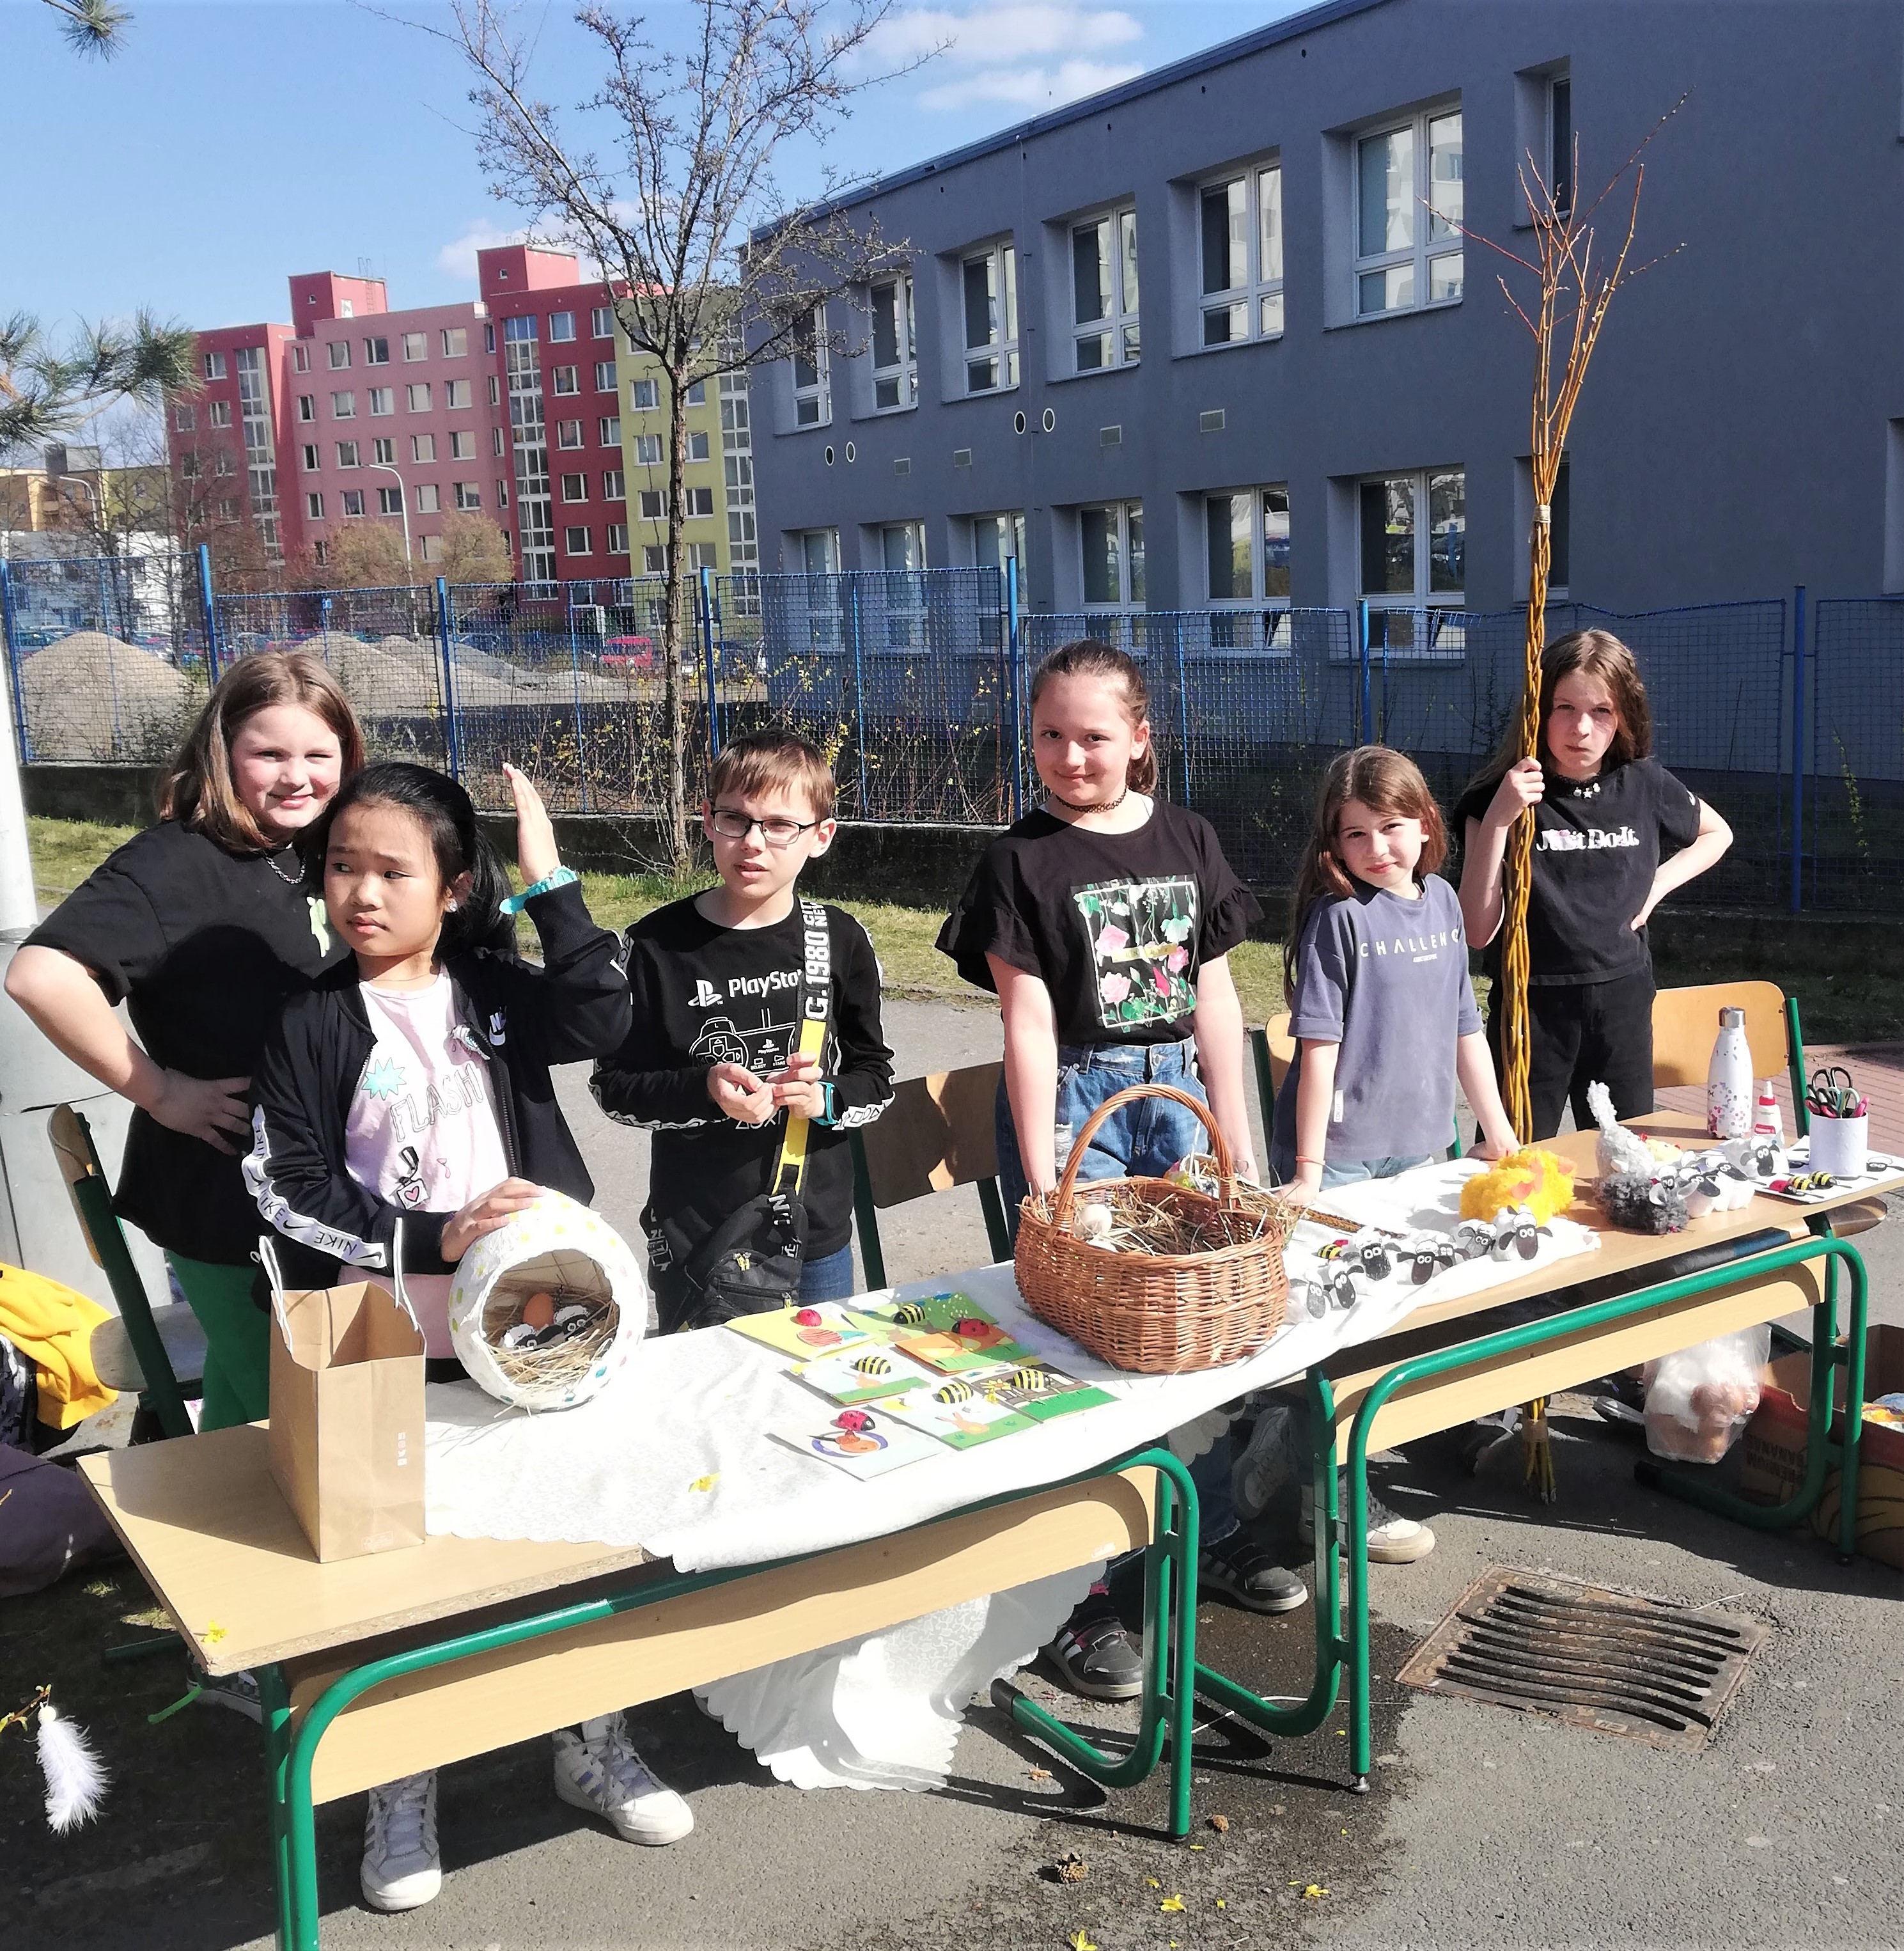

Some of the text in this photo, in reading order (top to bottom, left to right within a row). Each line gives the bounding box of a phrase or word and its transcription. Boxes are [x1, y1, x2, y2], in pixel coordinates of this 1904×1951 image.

[804, 930, 830, 1019] G. 1980
[389, 1063, 484, 1142] FLASH
[313, 1230, 357, 1257] NIKE
